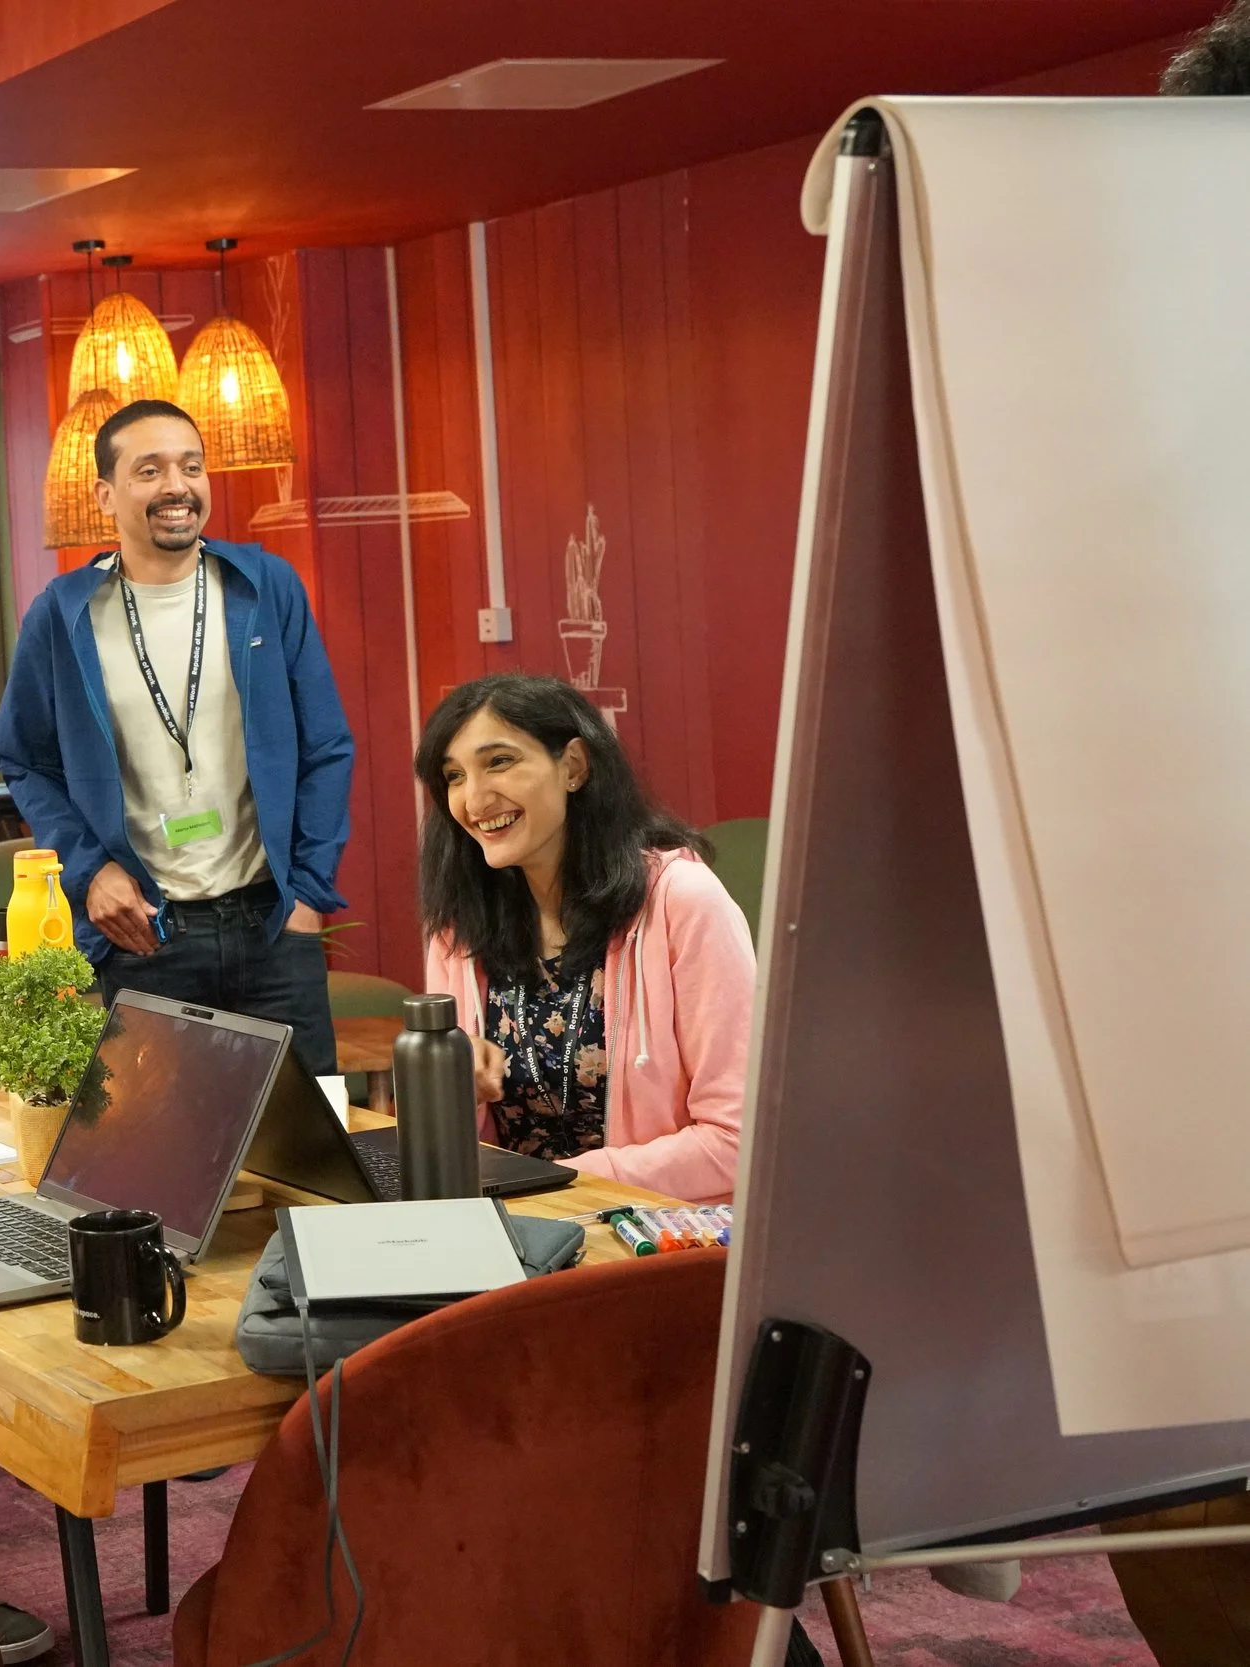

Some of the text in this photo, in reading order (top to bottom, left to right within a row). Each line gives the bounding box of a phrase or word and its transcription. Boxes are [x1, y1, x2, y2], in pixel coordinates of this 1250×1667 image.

[135, 633, 145, 661] Republic
[142, 661, 149, 669] of
[191, 620, 203, 676] Republic of Work.
[155, 692, 170, 721] Republic
[167, 721, 175, 729] of
[518, 1015, 528, 1039] Work.
[569, 992, 582, 1031] Republic
[526, 1047, 539, 1083] Republic
[563, 1039, 573, 1063] Work.
[563, 1065, 569, 1074] of
[80, 1310, 100, 1319] space.
